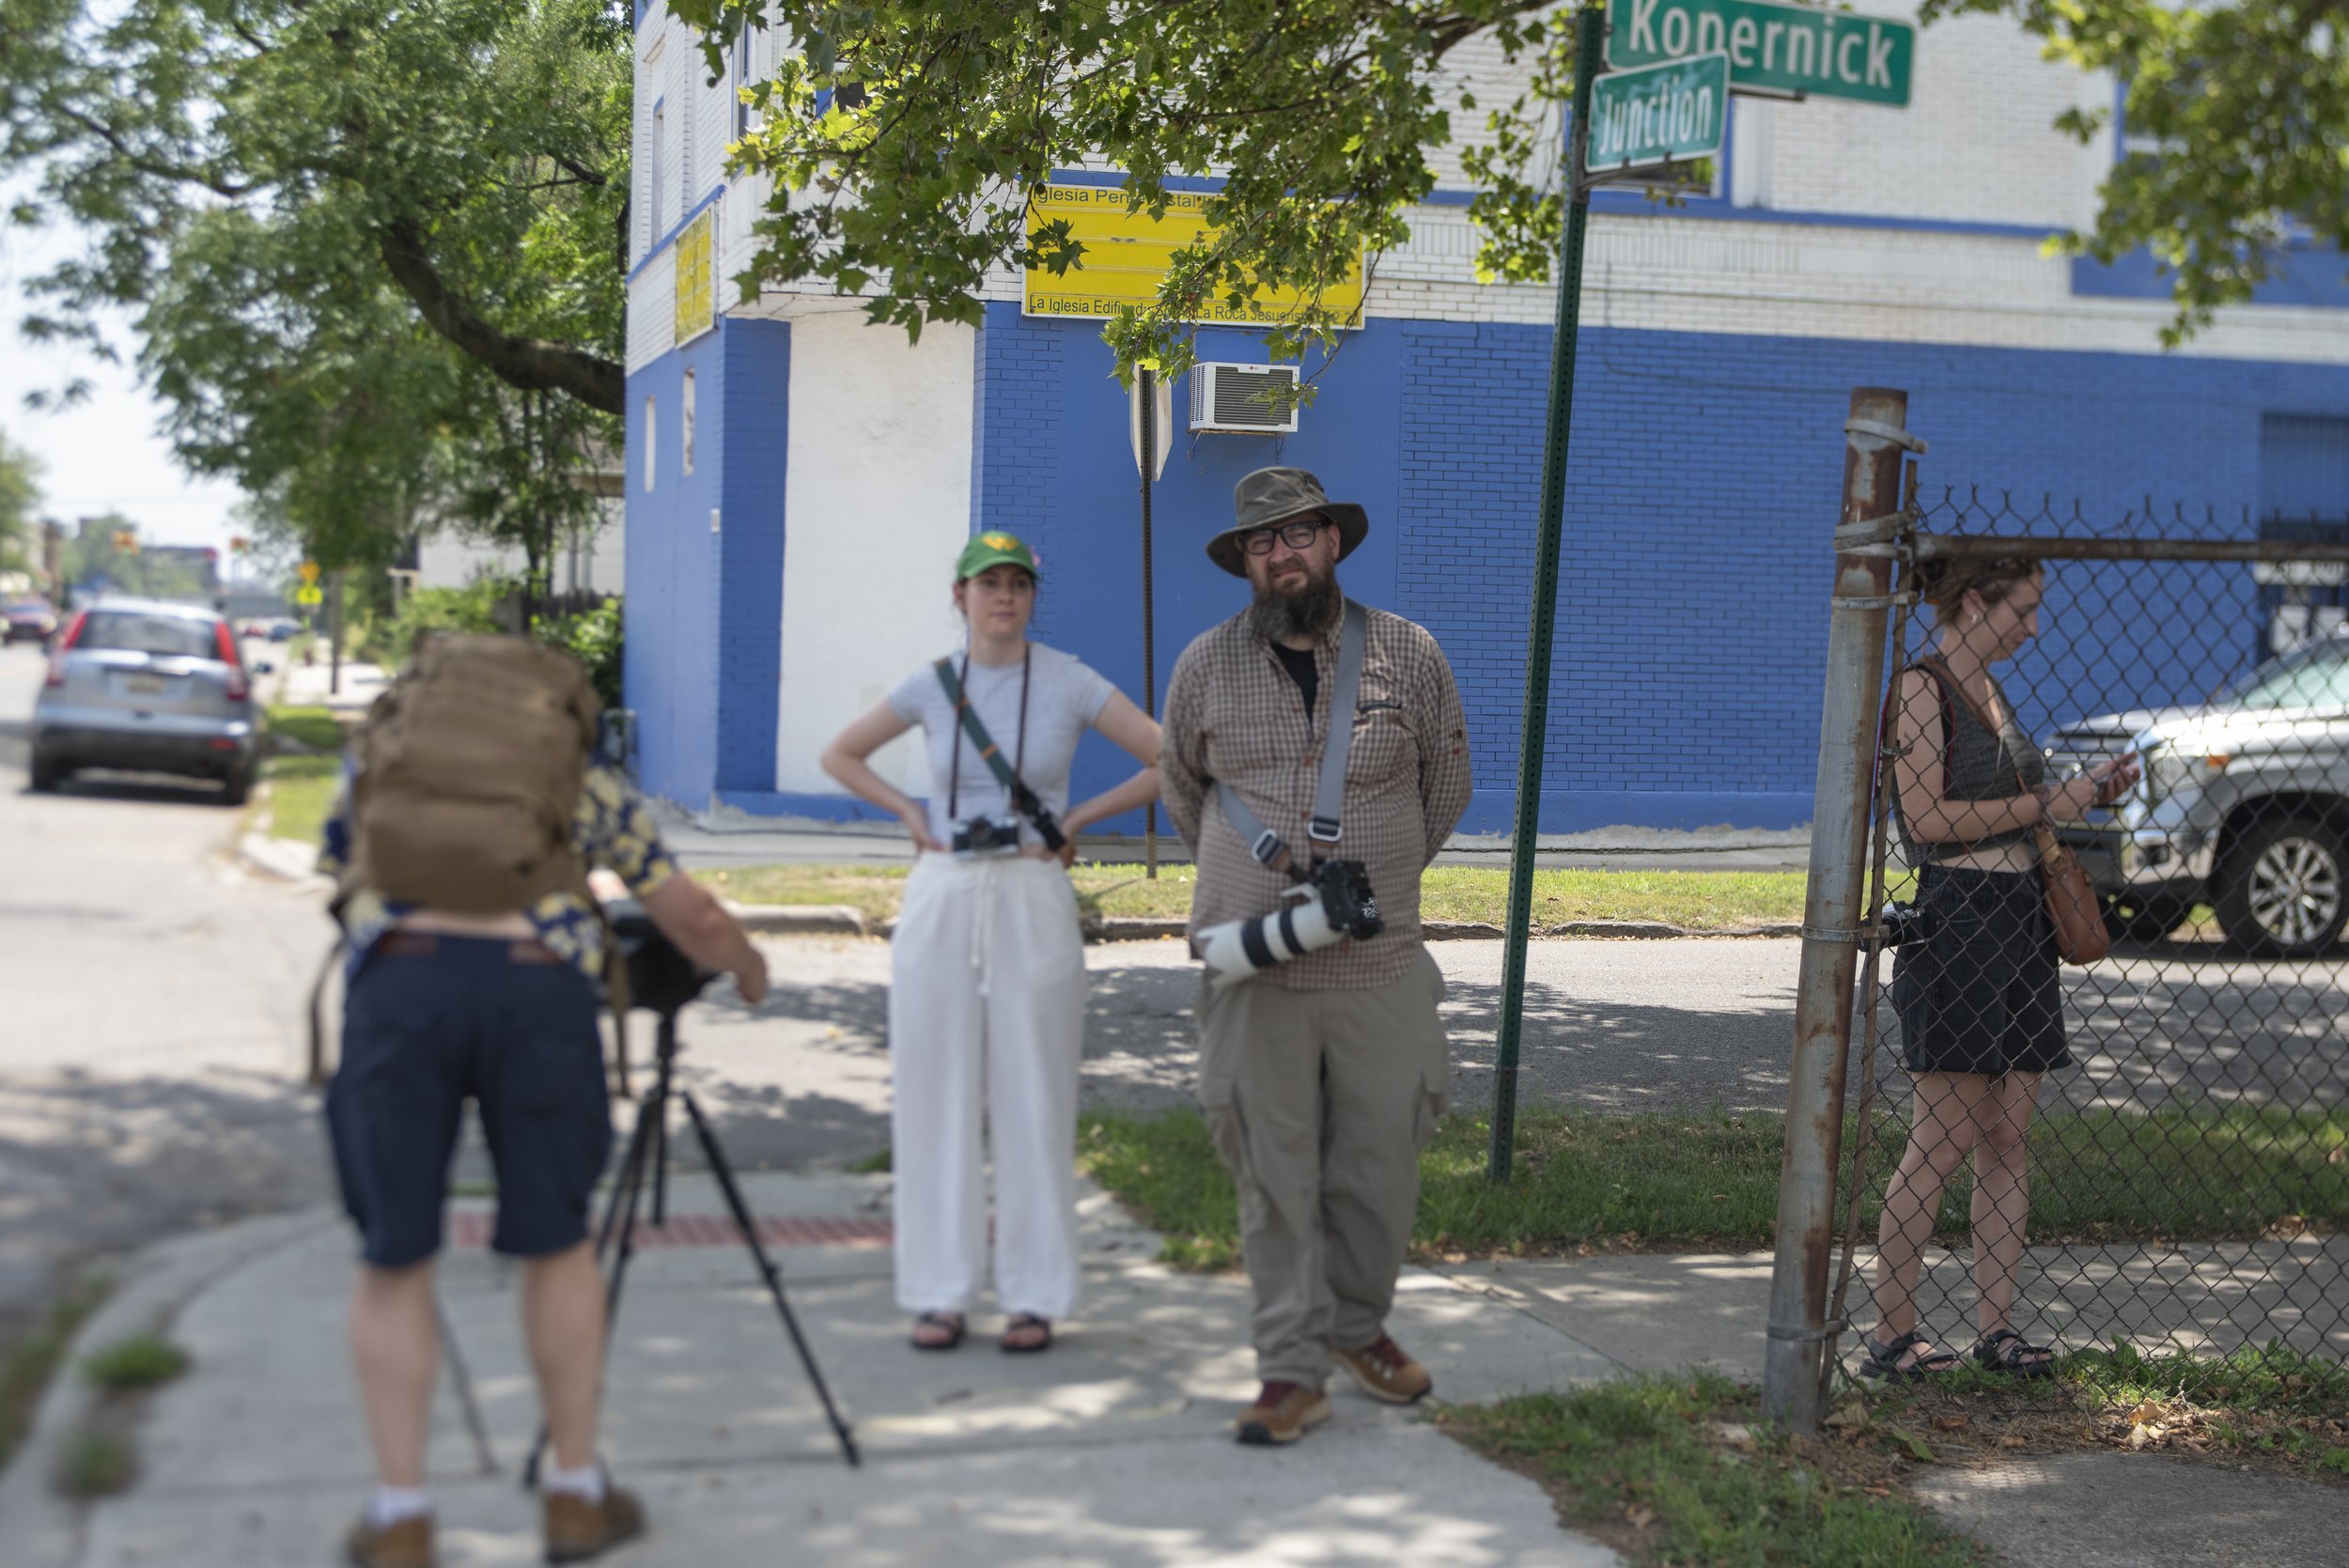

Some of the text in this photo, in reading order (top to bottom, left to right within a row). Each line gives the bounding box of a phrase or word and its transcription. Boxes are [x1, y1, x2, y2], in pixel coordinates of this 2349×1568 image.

[1598, 74, 1713, 156] Junction
[1029, 294, 1045, 309] La
[1049, 297, 1090, 315] Iglesia
[1196, 304, 1211, 318] La
[1215, 305, 1247, 320] Roca
